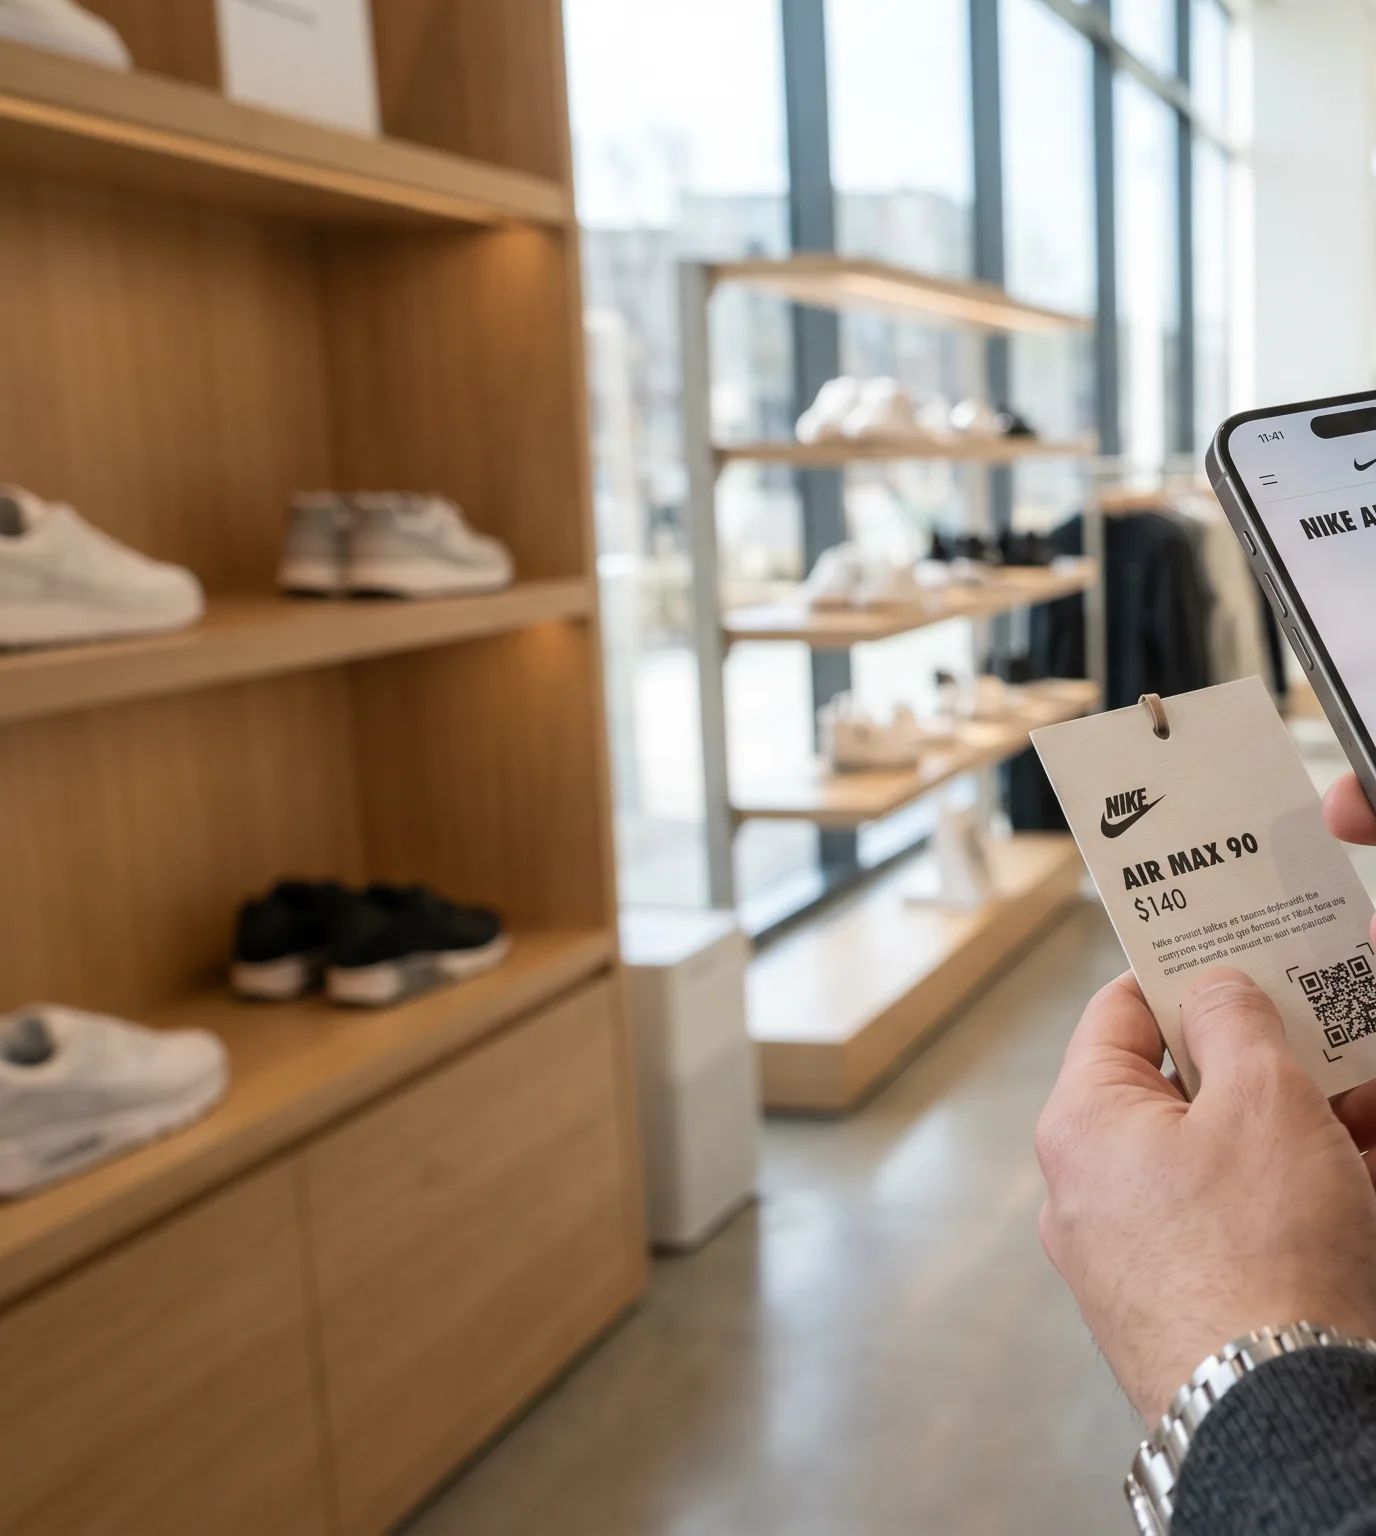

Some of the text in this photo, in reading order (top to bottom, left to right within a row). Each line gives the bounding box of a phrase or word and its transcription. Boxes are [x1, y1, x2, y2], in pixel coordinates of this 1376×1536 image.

[1257, 430, 1285, 444] 11:41
[1299, 510, 1358, 540] NIKE
[1105, 787, 1149, 819] NIKE
[1122, 832, 1258, 890] AIR MAX 90
[1134, 888, 1187, 922] $140
